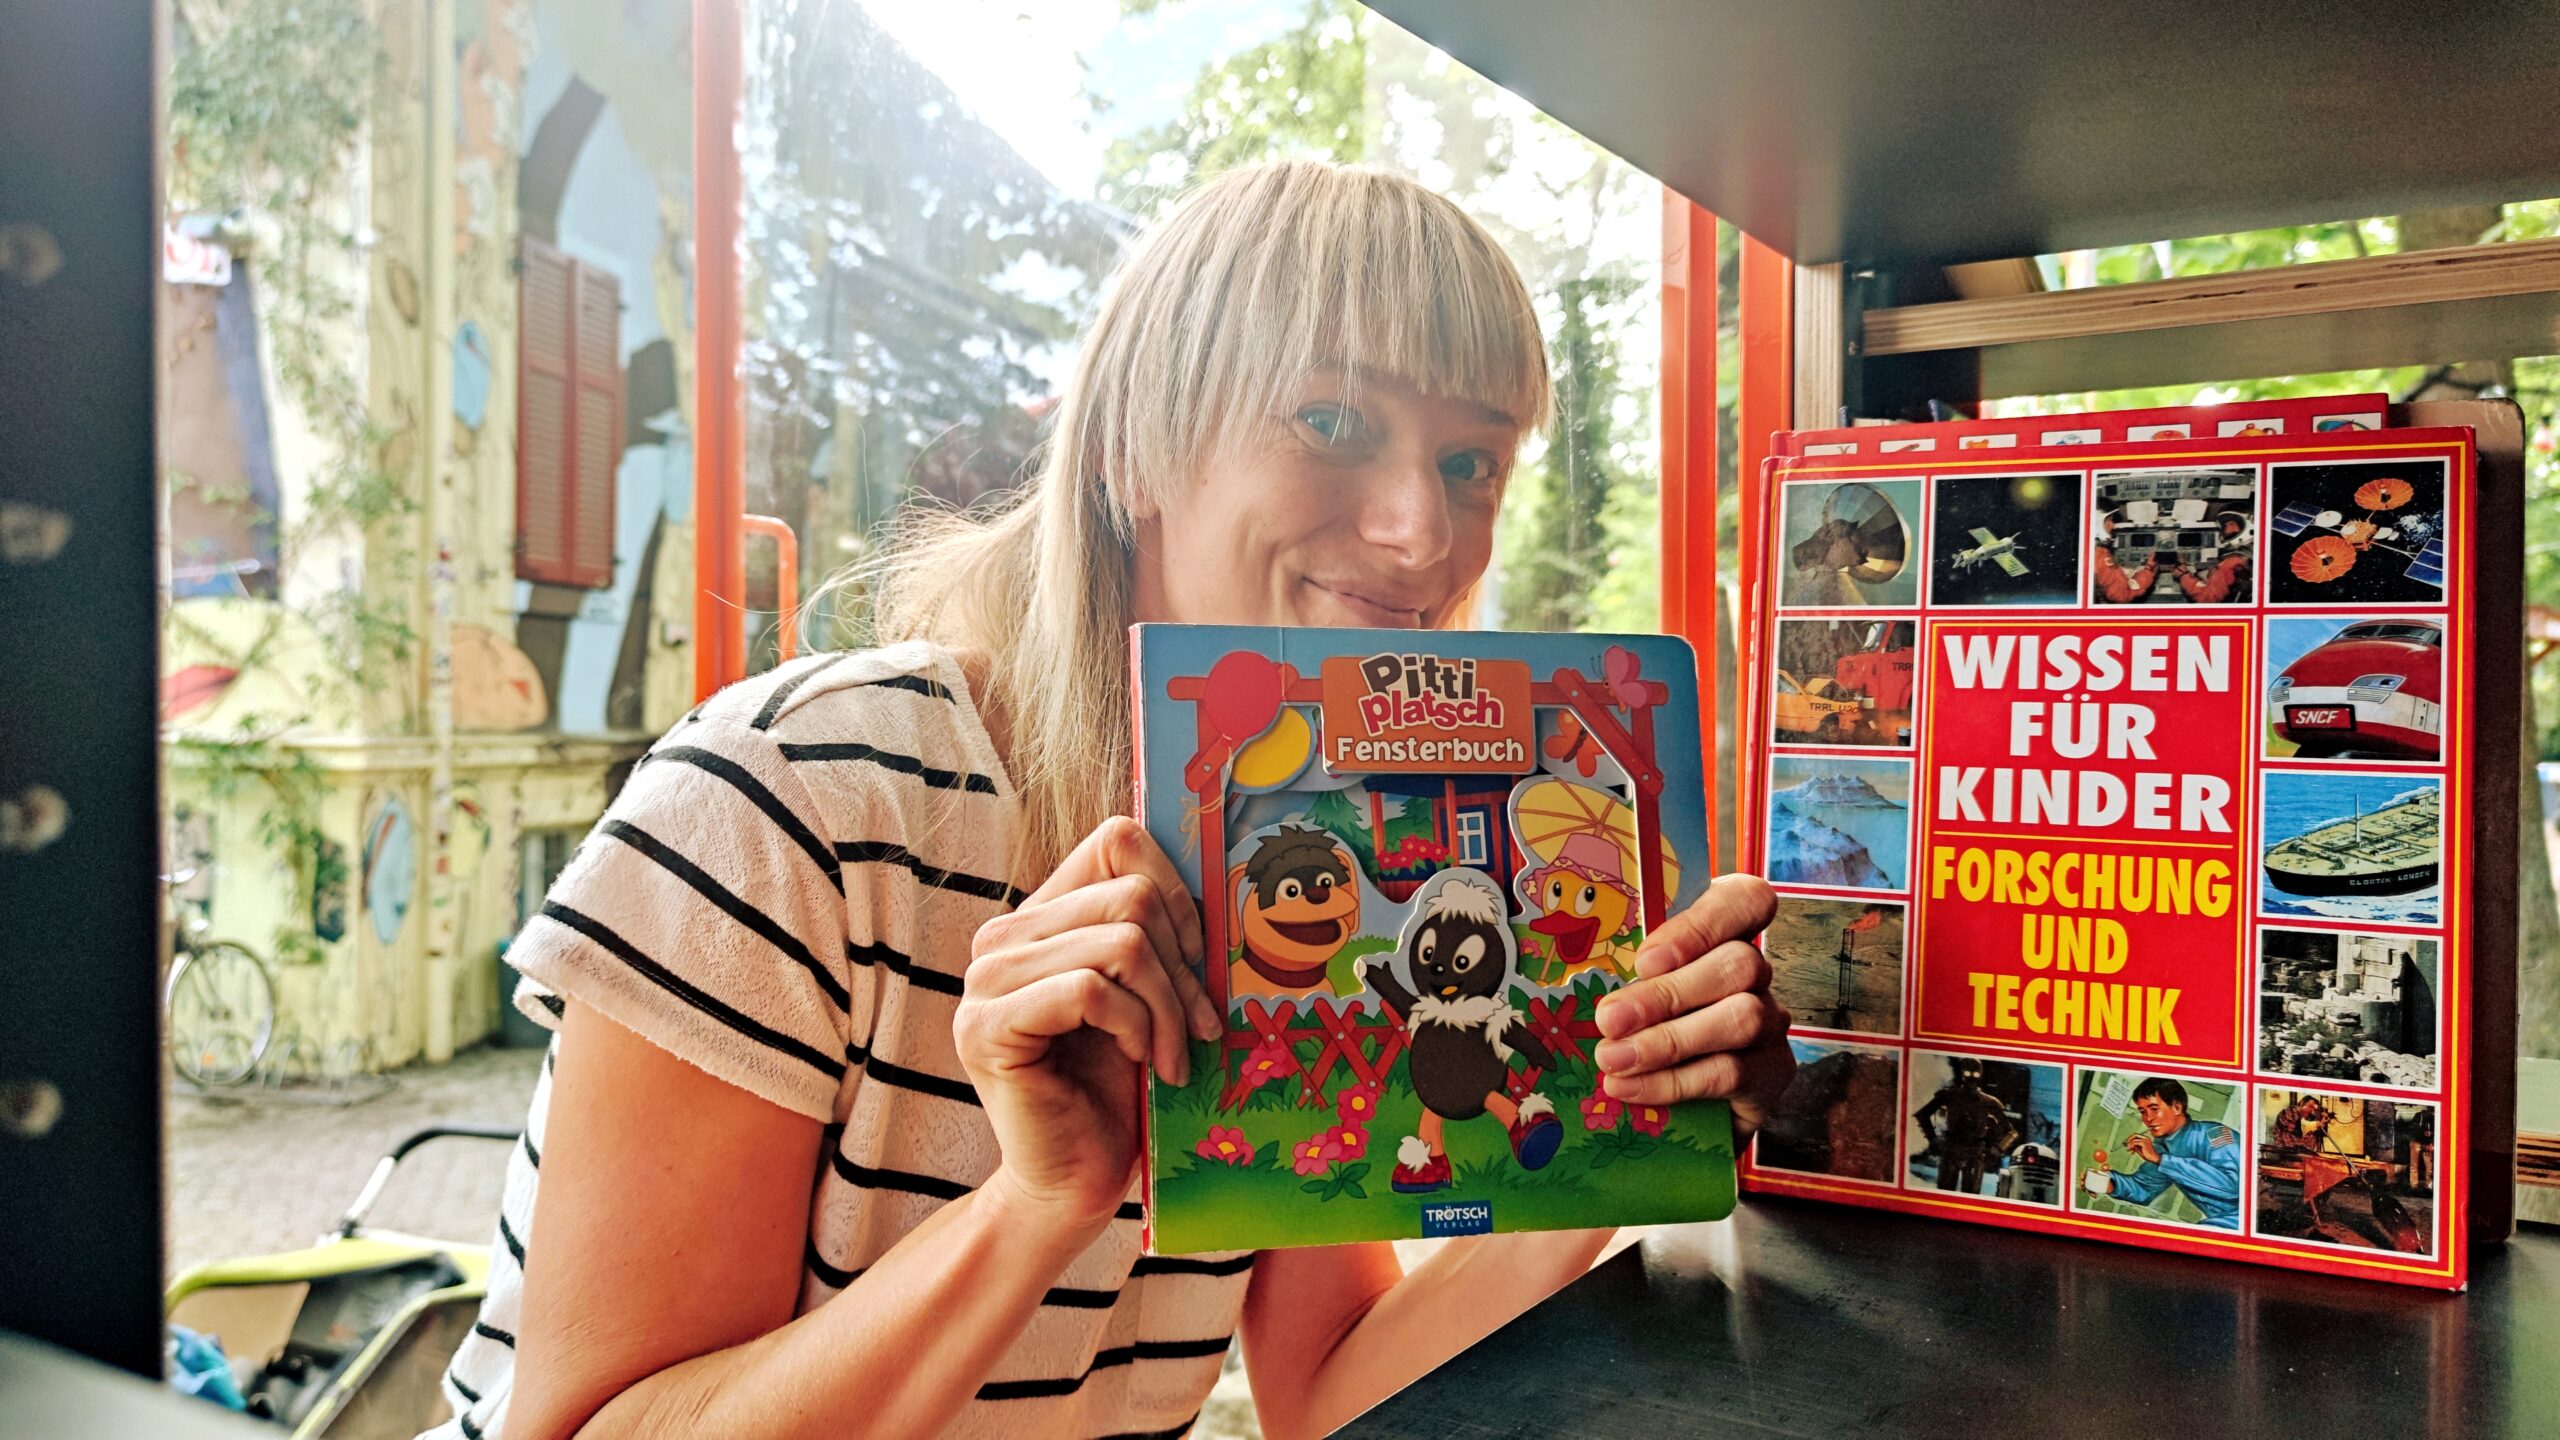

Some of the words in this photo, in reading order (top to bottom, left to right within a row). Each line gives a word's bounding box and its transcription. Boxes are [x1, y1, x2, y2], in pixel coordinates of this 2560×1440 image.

[1360, 653, 1476, 699] Pitti
[1943, 635, 2230, 692] WISSEN
[1359, 688, 1503, 735] platsch
[1809, 702, 1835, 712] TRRL
[2010, 692, 2157, 760] FÜR
[2295, 710, 2340, 724] SNCF
[1336, 737, 1524, 762] Fensterbuch
[1938, 767, 2232, 833] KINDER
[1932, 847, 2232, 918] FORSCHUNG
[2022, 915, 2129, 974] UND
[1969, 973, 2182, 1046] TECHNIK
[1426, 1205, 1488, 1222] TRÖTSCH
[1435, 1220, 1480, 1229] VERLAG
